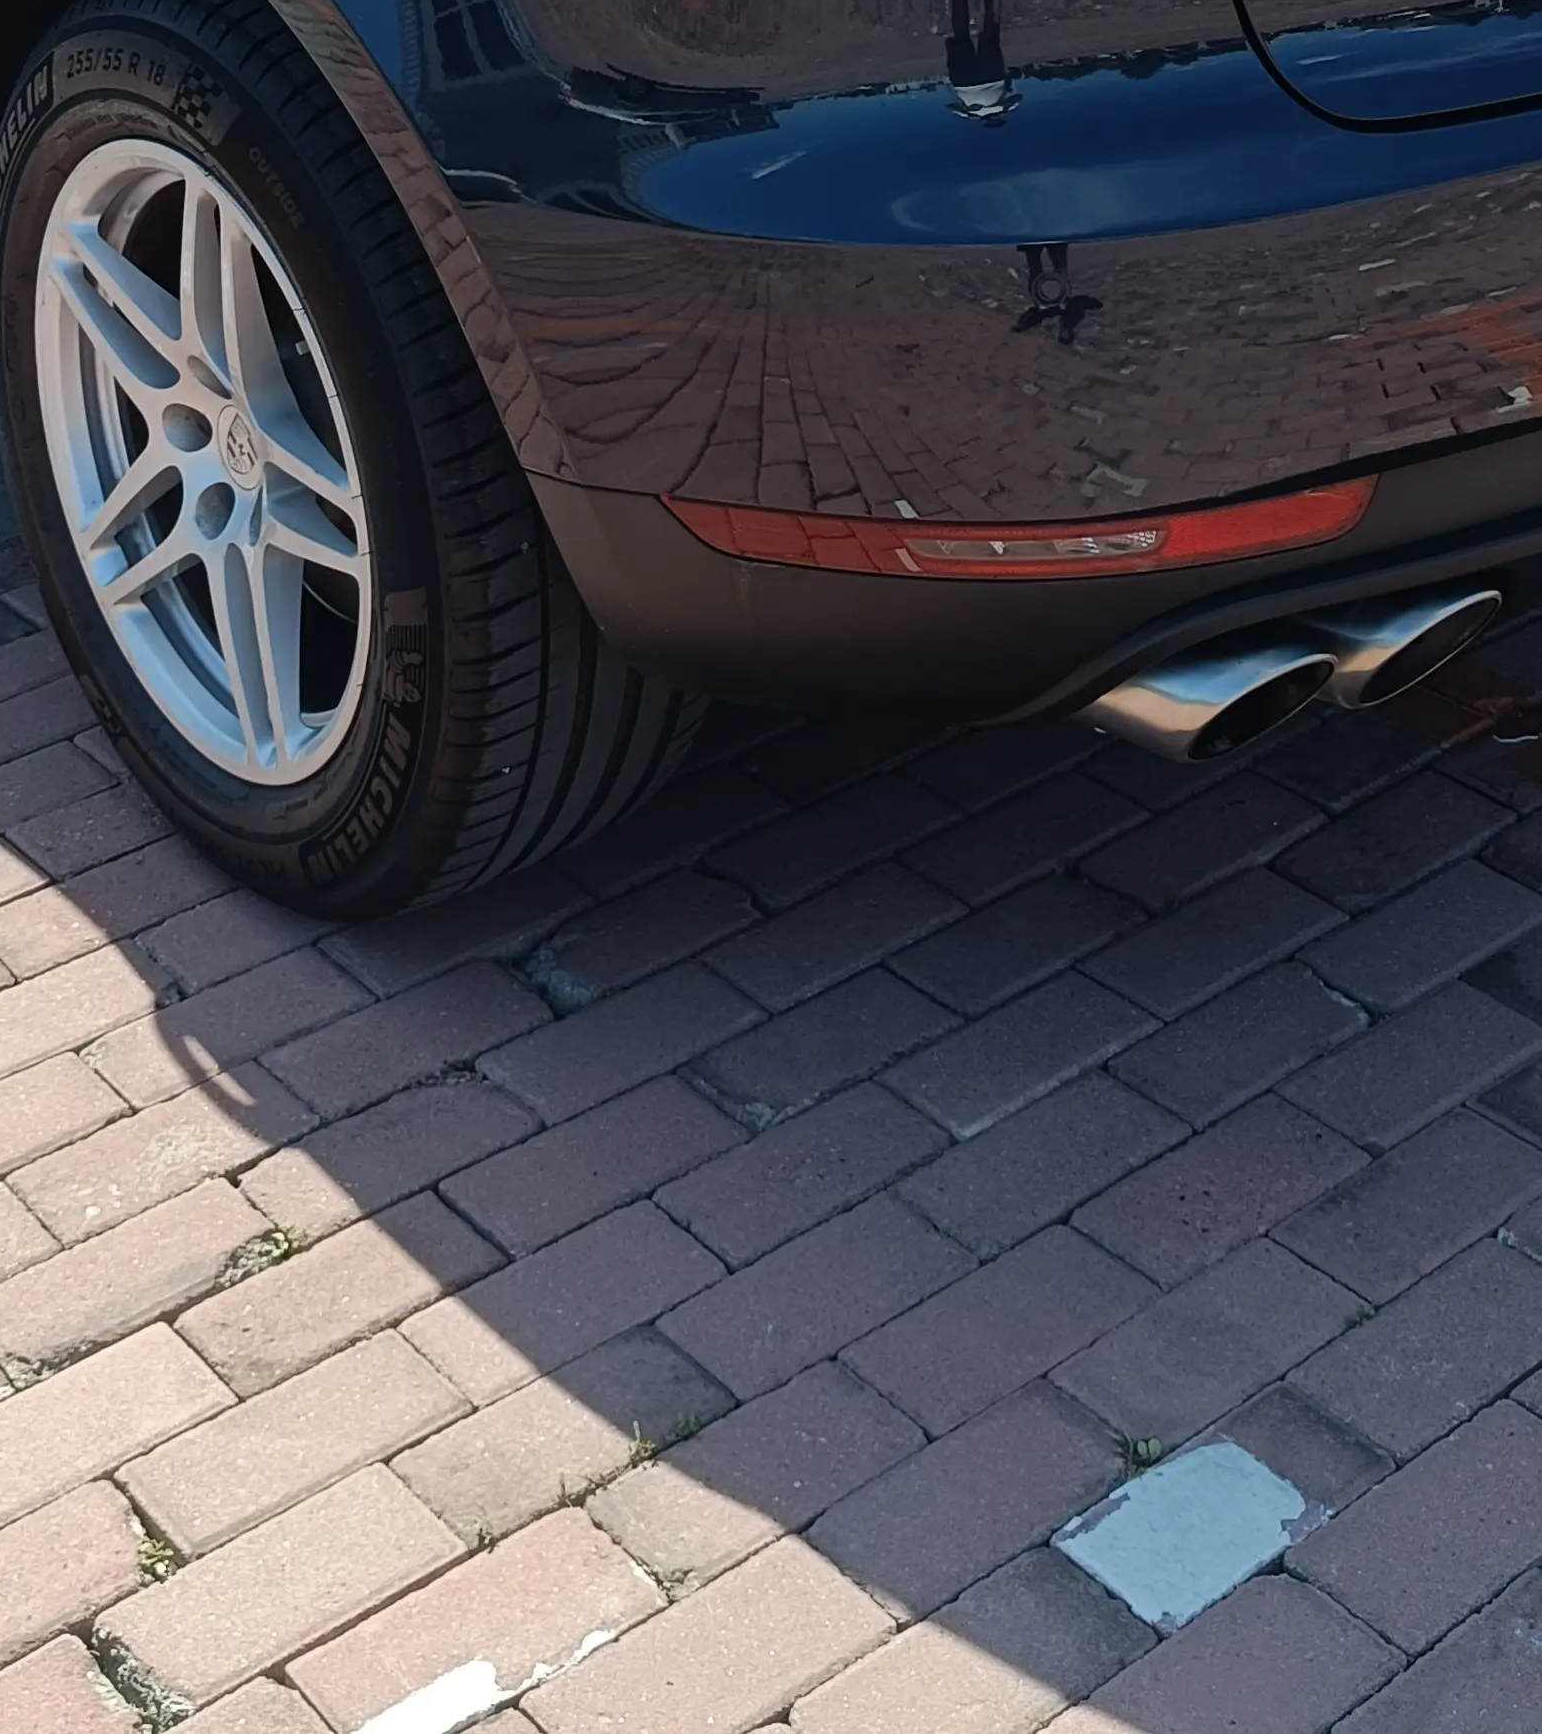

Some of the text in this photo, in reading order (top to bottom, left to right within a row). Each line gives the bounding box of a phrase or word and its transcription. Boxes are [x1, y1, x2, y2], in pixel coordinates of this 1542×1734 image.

[66, 47, 166, 86] 255/55 R 18
[307, 712, 411, 884] MICHELIN
